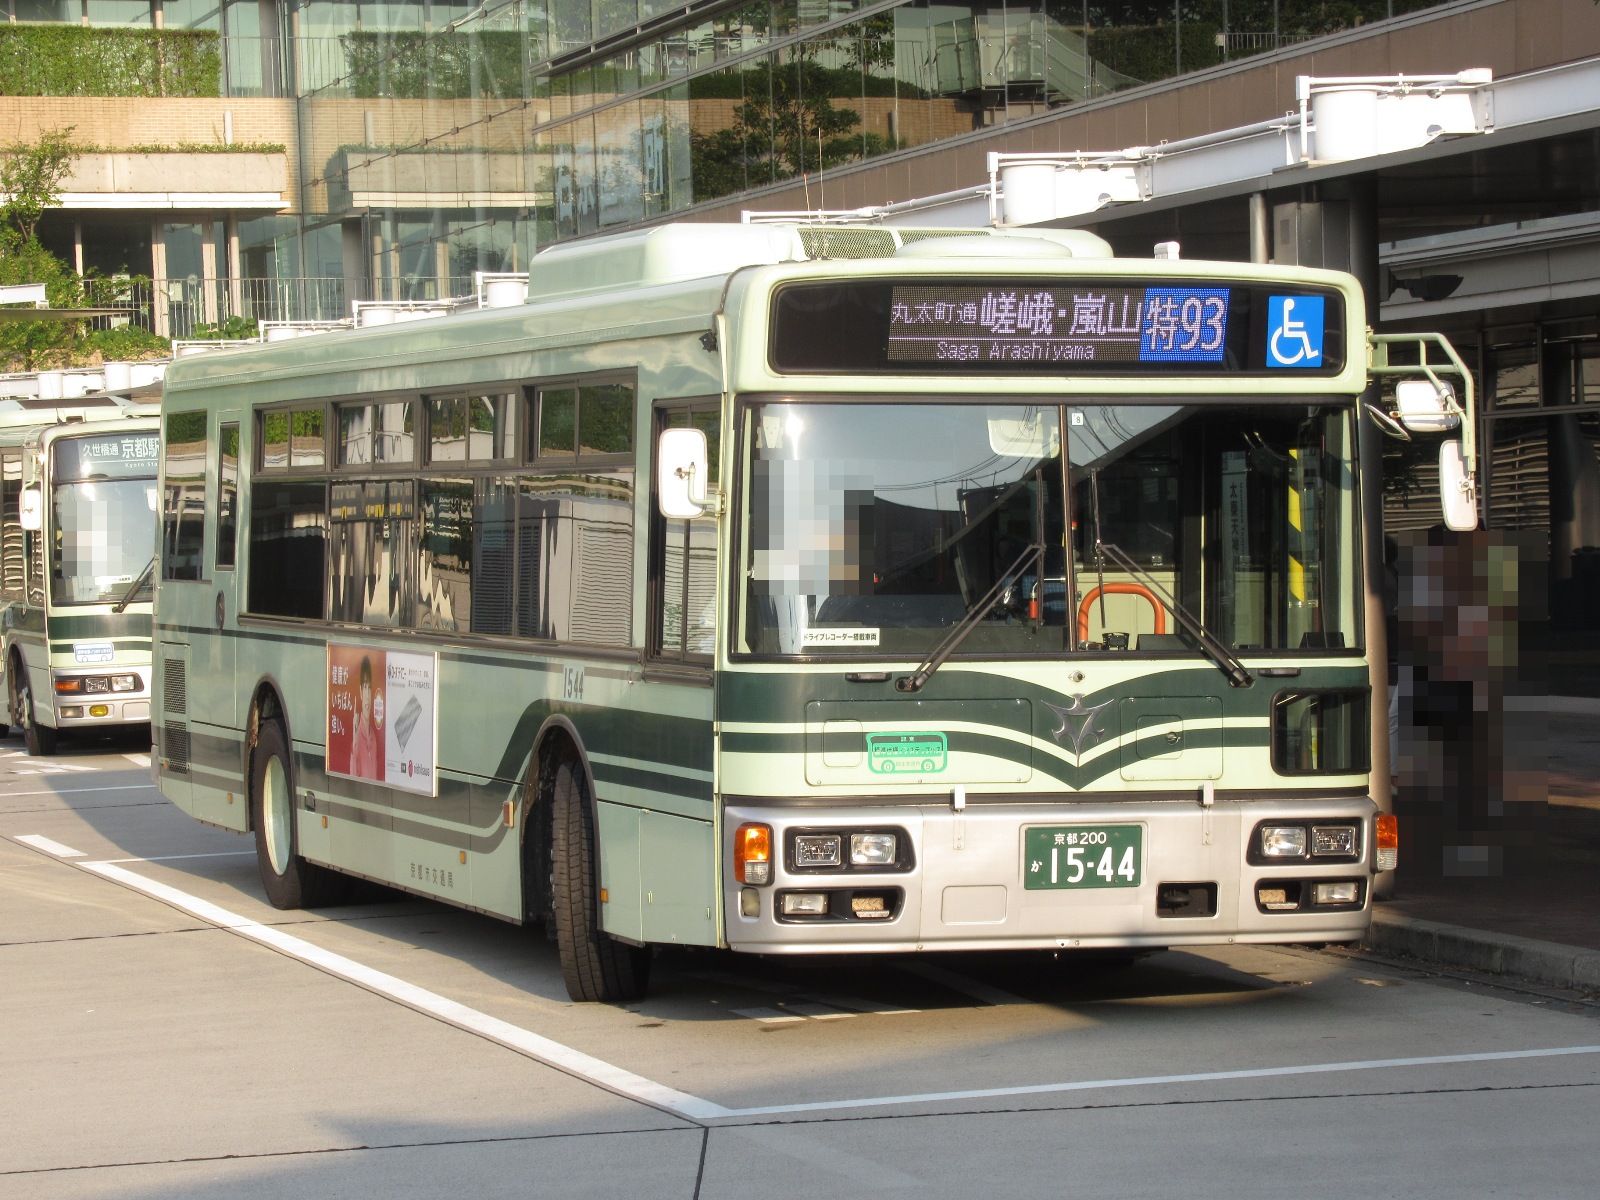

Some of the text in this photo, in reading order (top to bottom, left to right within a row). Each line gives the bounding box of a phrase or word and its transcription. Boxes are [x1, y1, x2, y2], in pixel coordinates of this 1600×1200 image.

[892, 292, 1226, 351] 丸太町通 嵯峨・嵐山 特93
[937, 341, 1095, 361] Saga Arashiyama
[82, 442, 119, 457] 久世橋通
[563, 667, 584, 700] 1544
[1031, 846, 1135, 884] か 15-44
